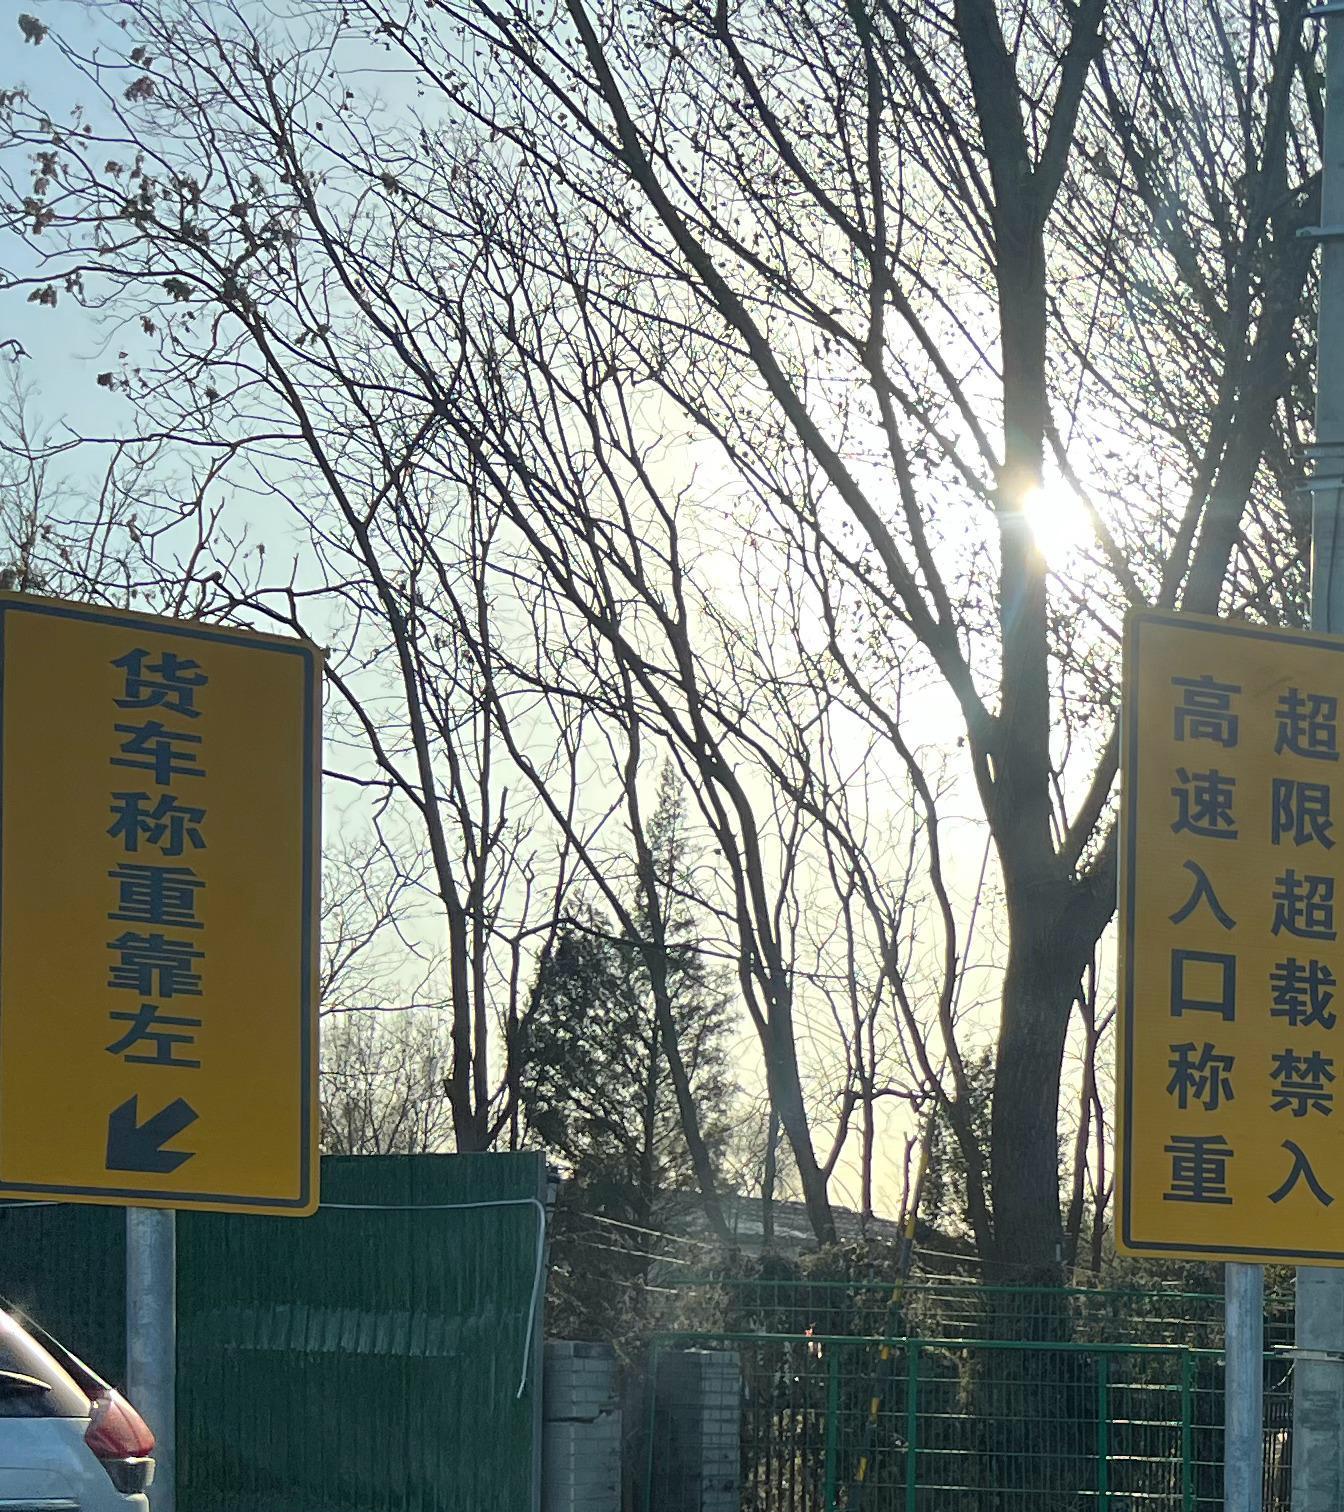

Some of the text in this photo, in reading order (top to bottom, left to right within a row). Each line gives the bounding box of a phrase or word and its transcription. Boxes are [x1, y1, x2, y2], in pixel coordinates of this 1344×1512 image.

[105, 647, 209, 1069] 货车称重靠左
[1163, 674, 1242, 1206] 高速入口称重
[1267, 688, 1341, 1207] 超限超载禁入
